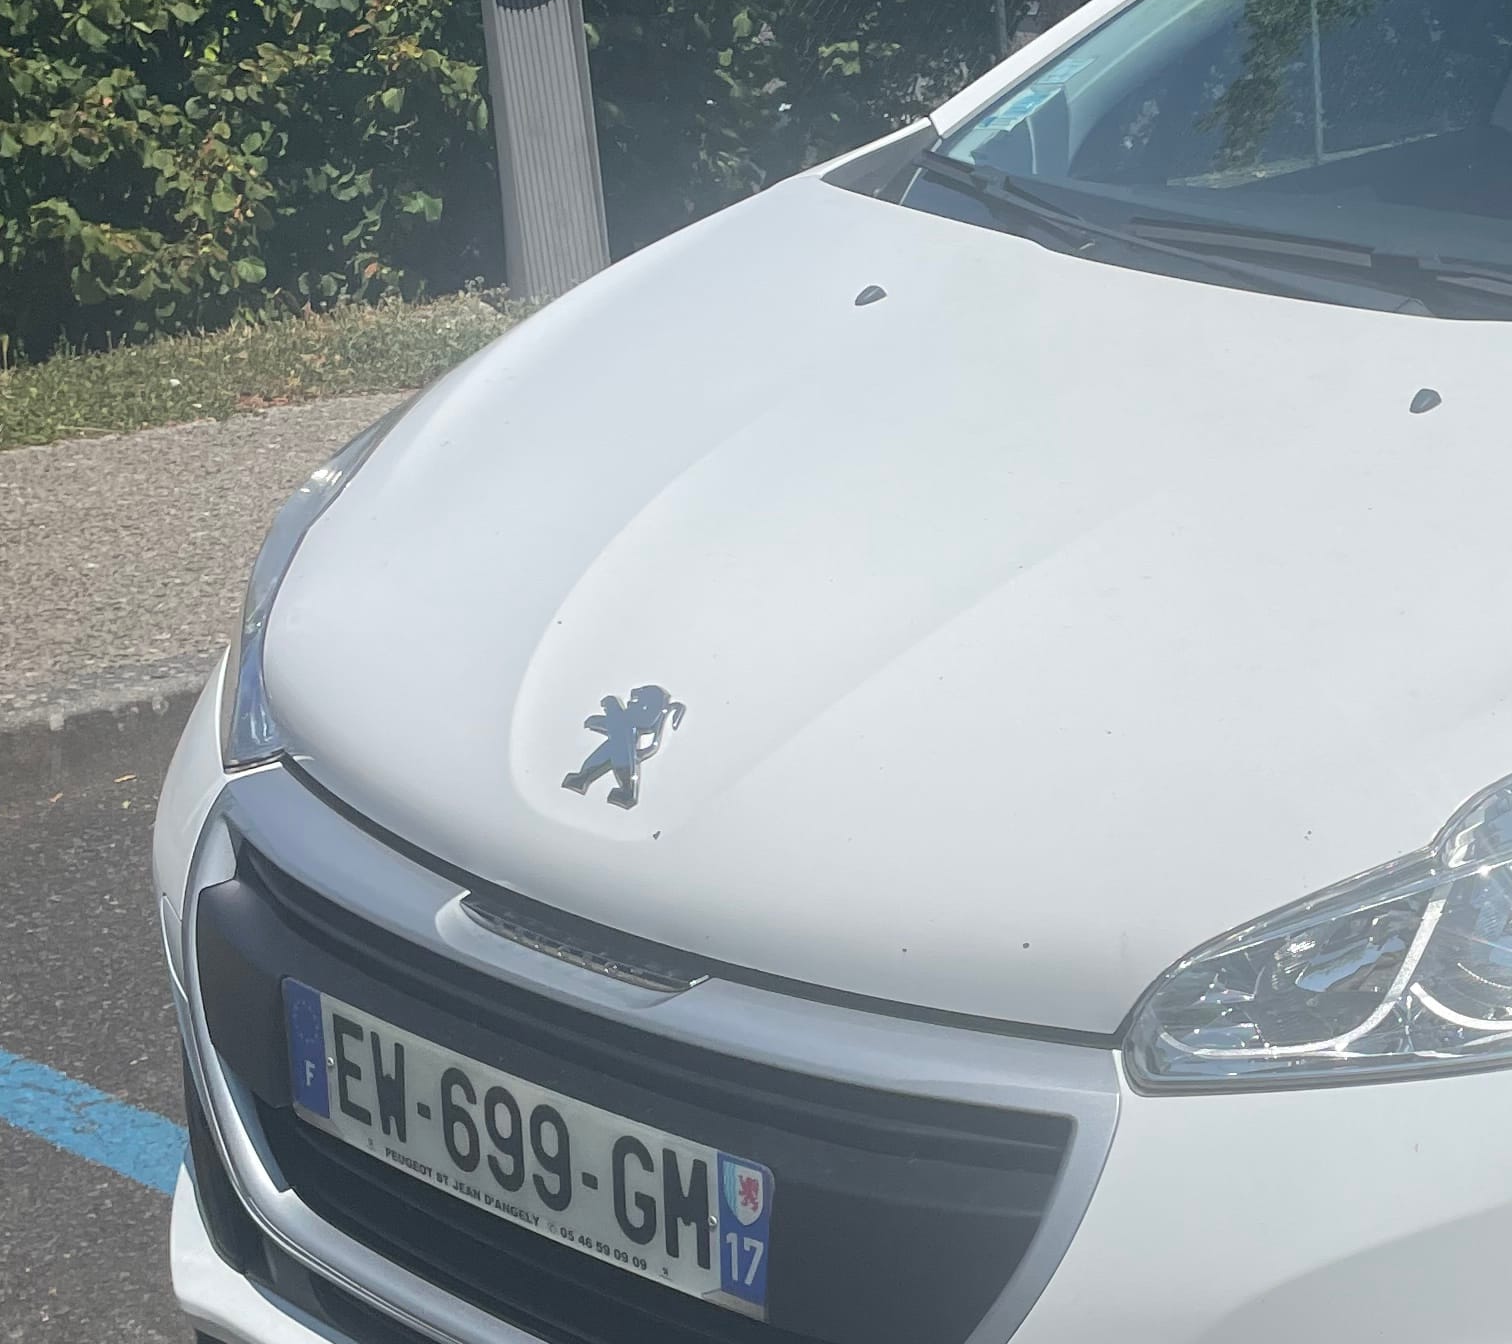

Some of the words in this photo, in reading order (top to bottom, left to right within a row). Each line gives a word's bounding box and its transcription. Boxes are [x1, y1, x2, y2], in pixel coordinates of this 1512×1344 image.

[304, 1060, 316, 1088] F
[332, 1013, 711, 1270] EW-699-GM
[385, 1147, 433, 1178] PEUGEOT
[453, 1179, 481, 1201] JEAN
[484, 1193, 540, 1227] D'ANGELY
[560, 1227, 575, 1242] 05
[578, 1235, 593, 1249] 46
[596, 1241, 611, 1256] 59
[614, 1248, 629, 1263] 09
[632, 1256, 648, 1271] 09
[725, 1232, 765, 1287] 17
